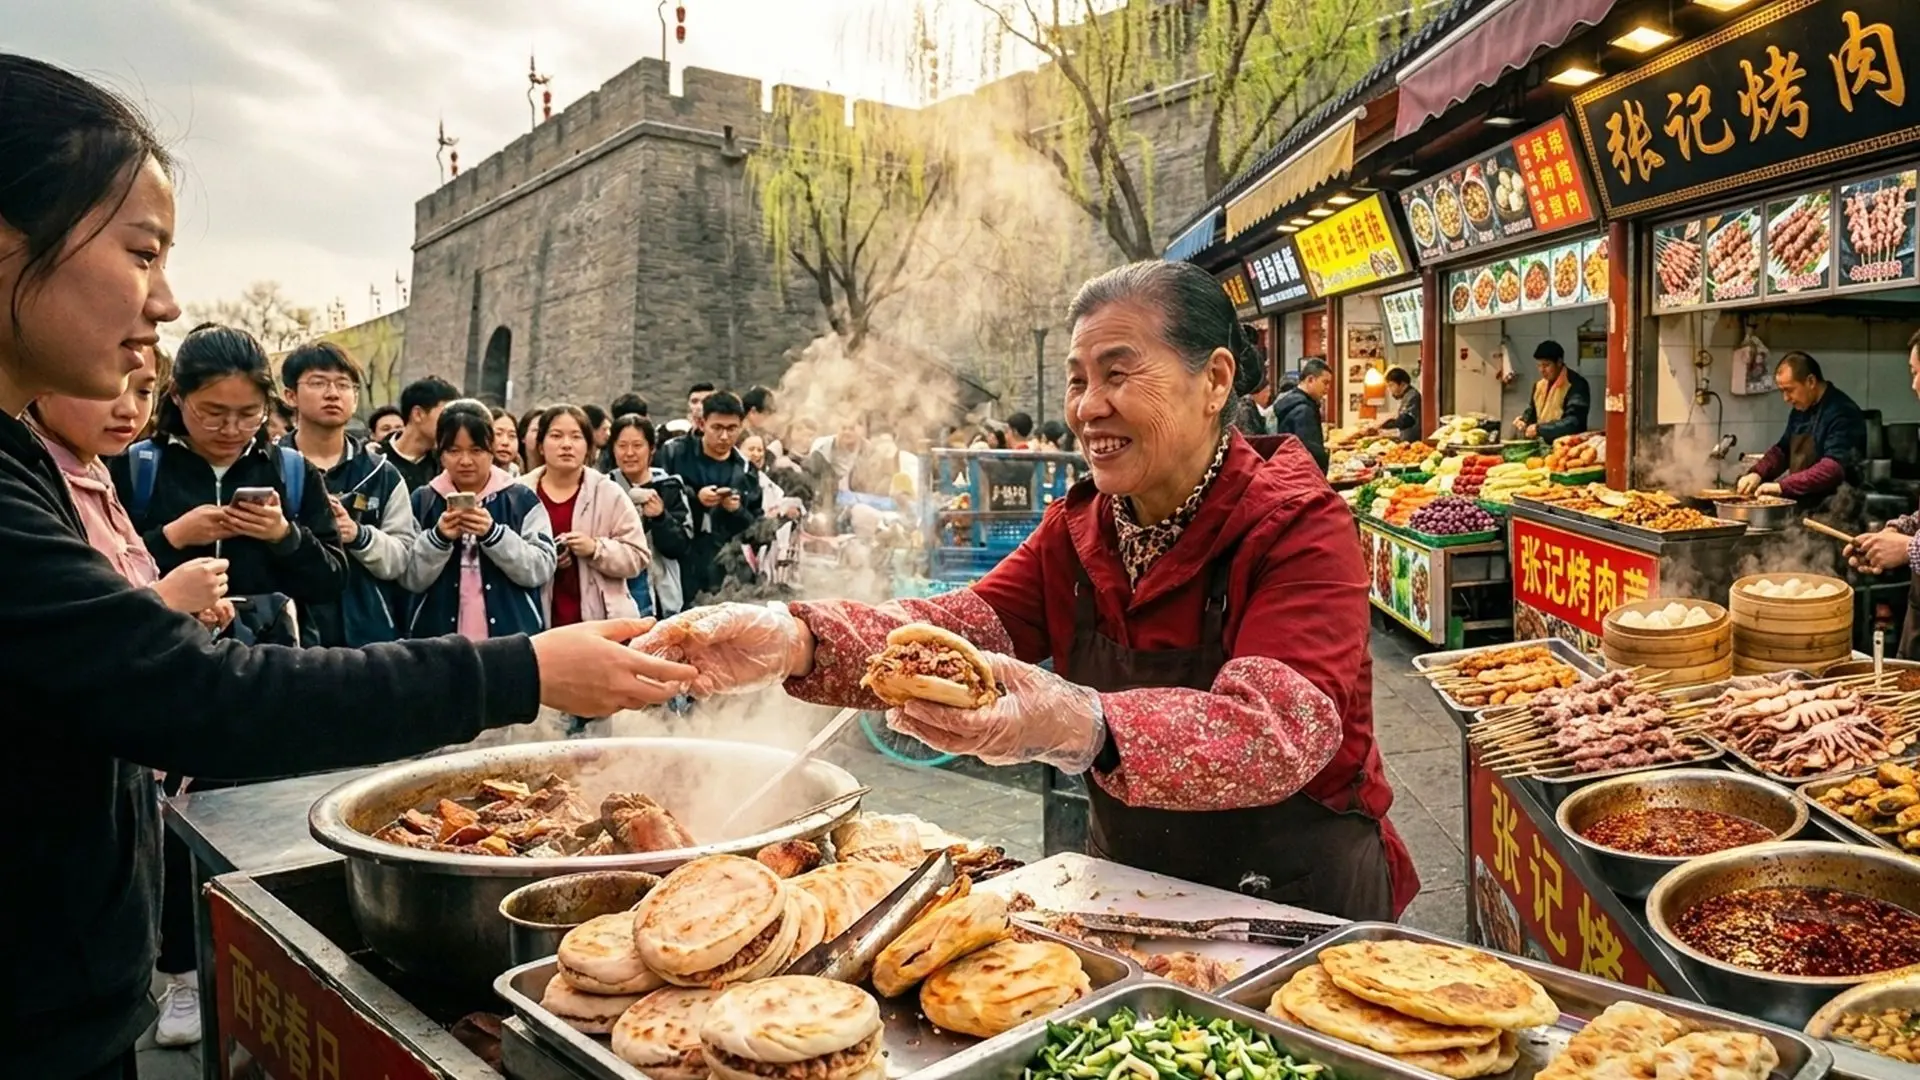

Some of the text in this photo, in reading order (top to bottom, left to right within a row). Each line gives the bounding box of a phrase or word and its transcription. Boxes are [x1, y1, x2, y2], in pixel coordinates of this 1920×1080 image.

[1605, 11, 1905, 185] 张记烤肉
[1491, 783, 1666, 994] 张记烤
